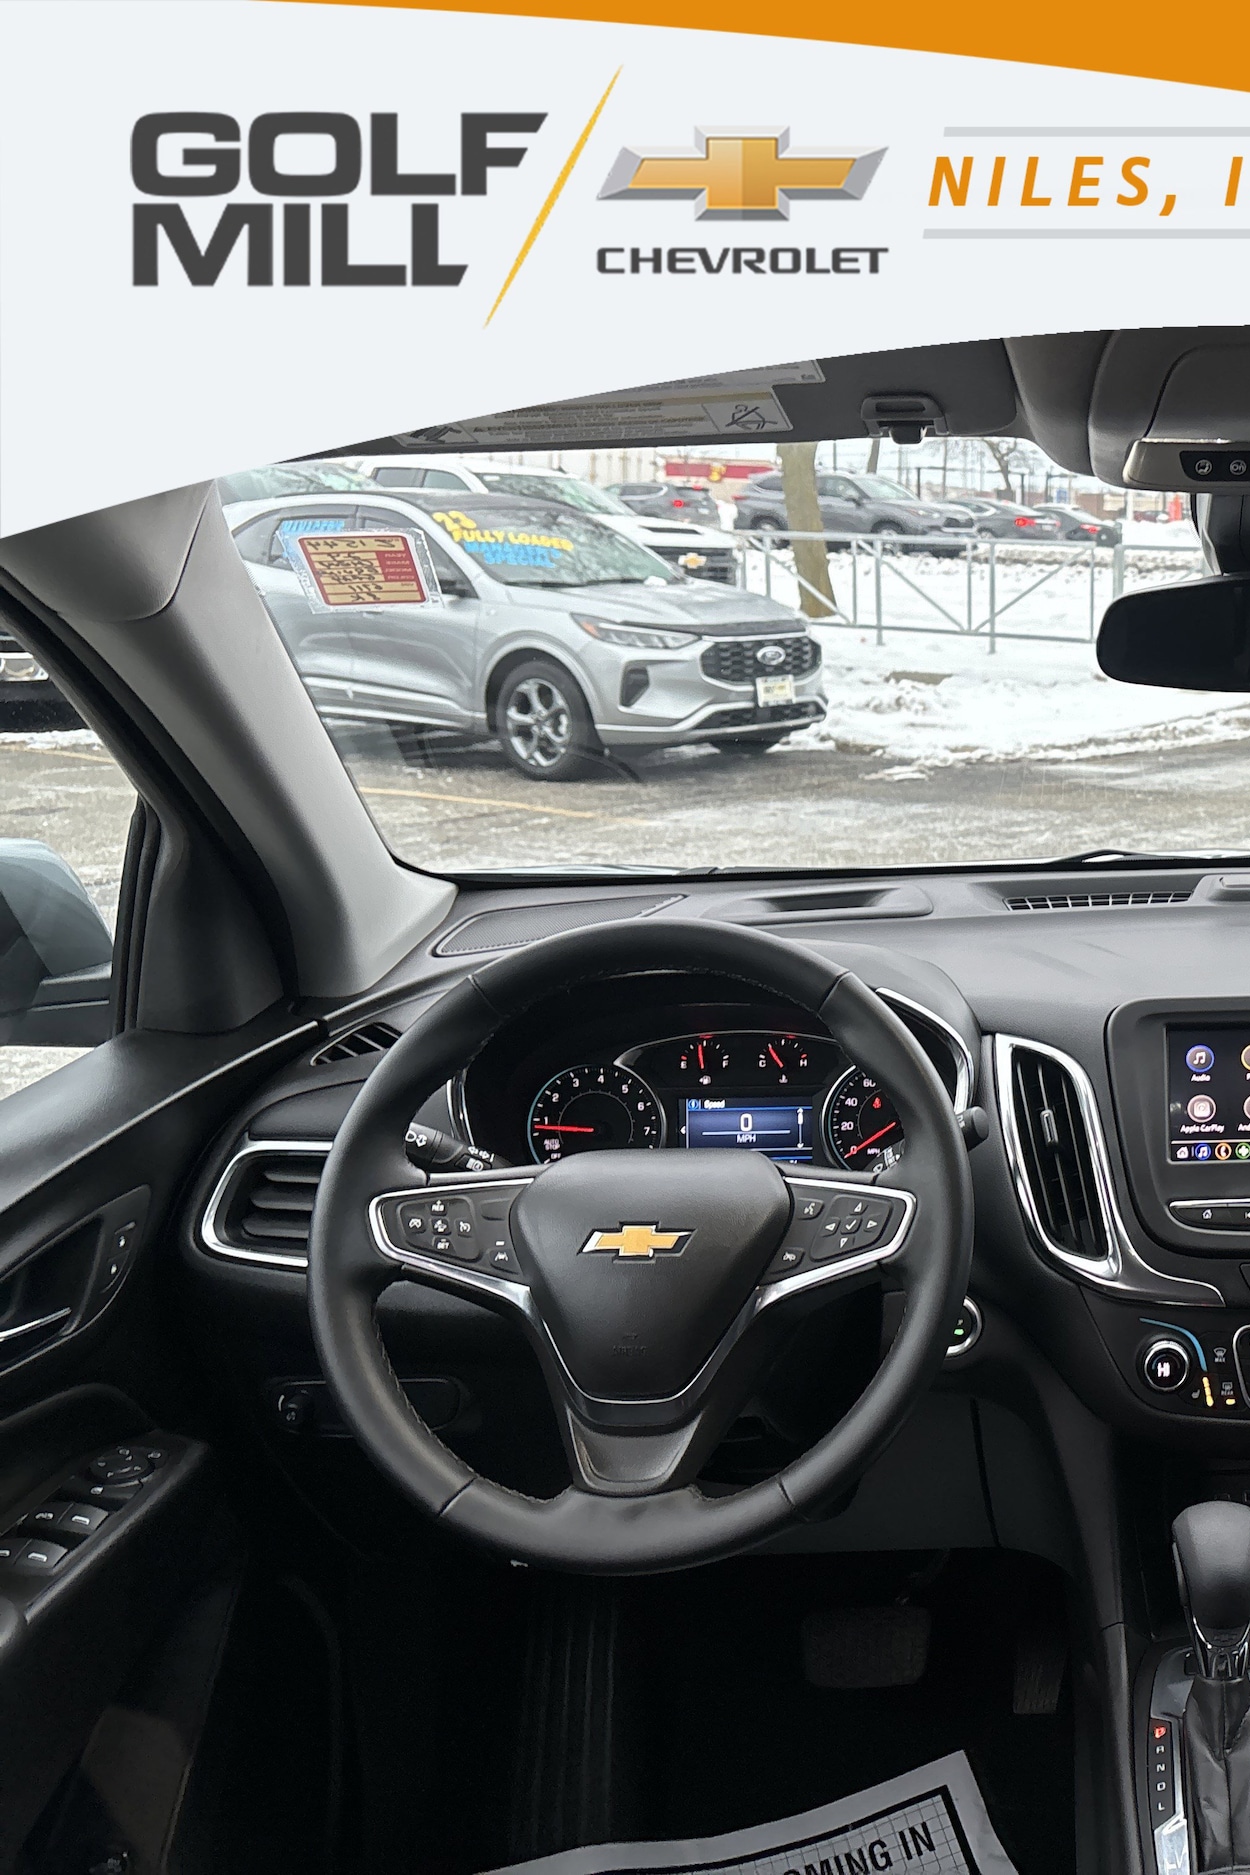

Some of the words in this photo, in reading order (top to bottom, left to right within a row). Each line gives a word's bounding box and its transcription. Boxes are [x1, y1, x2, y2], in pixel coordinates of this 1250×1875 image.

[680, 1061, 687, 1069] E
[722, 1060, 729, 1068] F
[759, 1060, 766, 1068] C
[800, 1059, 808, 1067] H
[572, 1079, 580, 1087] 3
[598, 1075, 605, 1084] 4
[621, 1085, 629, 1093] 5
[552, 1093, 559, 1102] 2
[637, 1102, 645, 1111] 6
[845, 1098, 858, 1107] 40
[740, 1113, 753, 1132] 0
[841, 1121, 854, 1130] 20
[644, 1127, 651, 1135] 7
[736, 1134, 756, 1143] MPH
[1157, 1362, 1170, 1377] HI
[1157, 1764, 1166, 1772] N
[1157, 1782, 1166, 1791] D
[1158, 1802, 1165, 1810] L
[899, 1822, 936, 1860] IN
